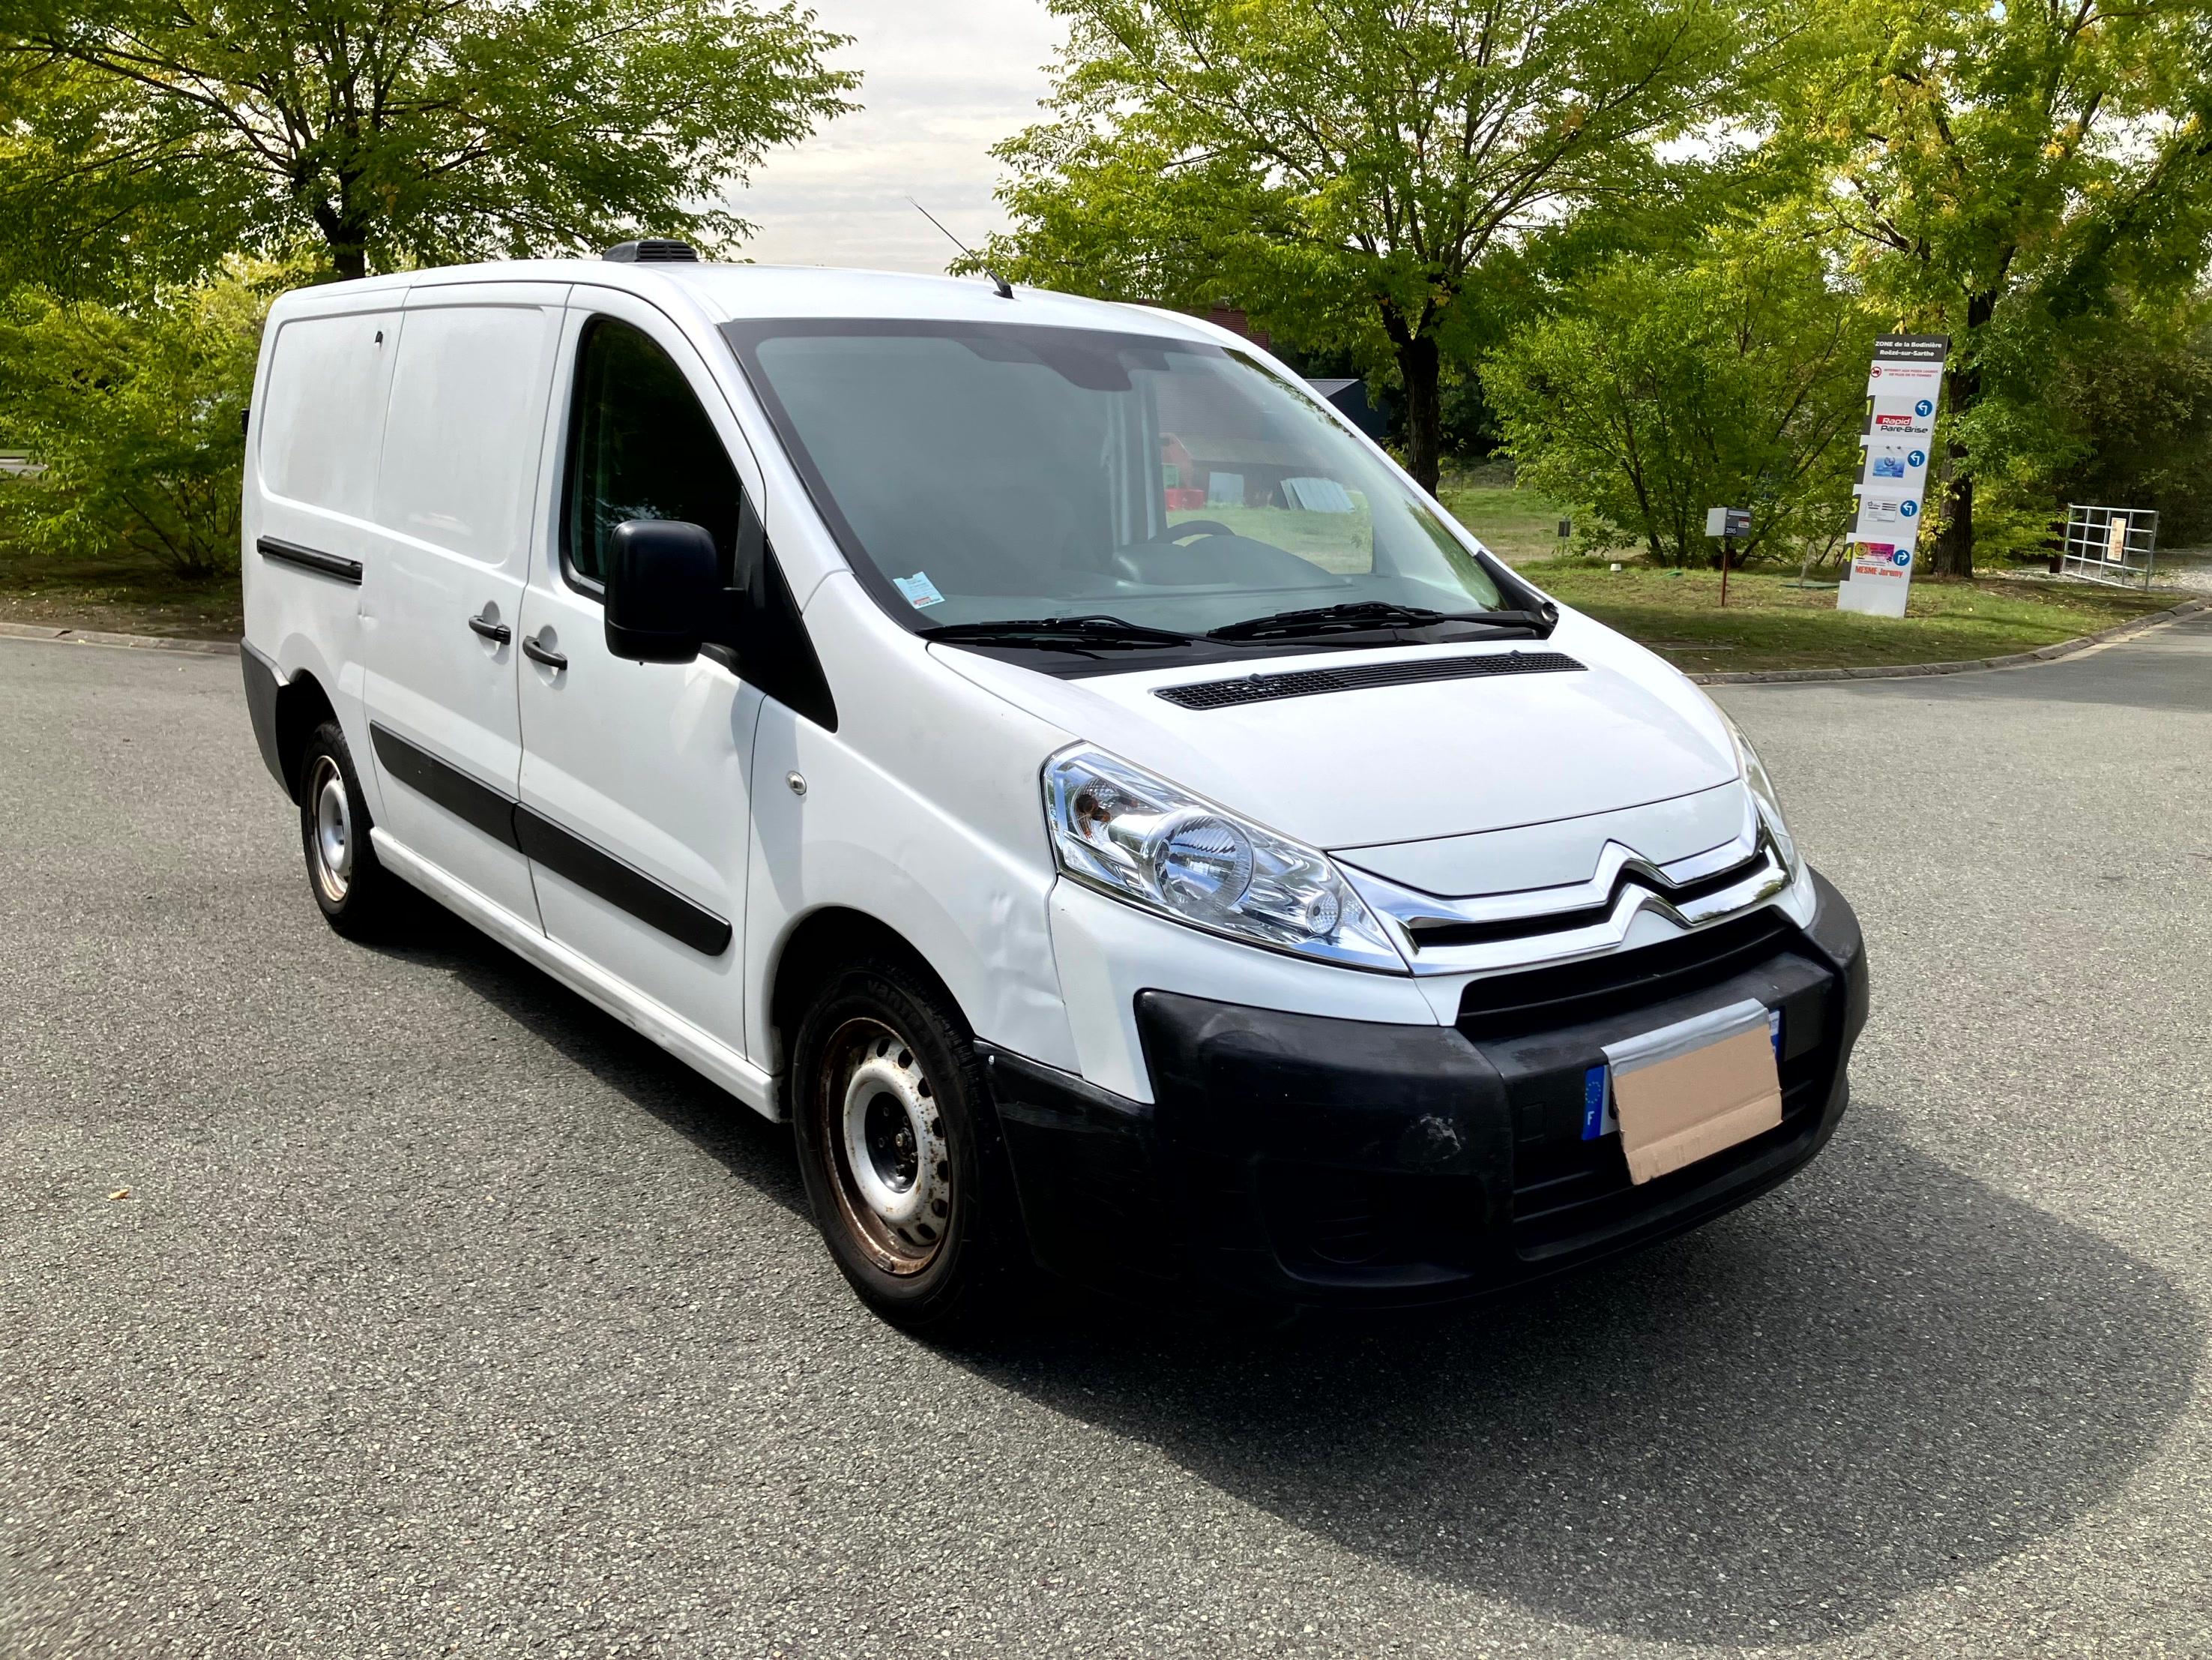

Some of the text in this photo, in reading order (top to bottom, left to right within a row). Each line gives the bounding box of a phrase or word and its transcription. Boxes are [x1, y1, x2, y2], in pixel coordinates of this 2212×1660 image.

[1866, 400, 1872, 415] 1
[1882, 417, 1911, 425] Rapid
[1880, 425, 1929, 433] Pare-Brise
[1857, 449, 1866, 465] 2
[1850, 498, 1859, 514] 3
[1843, 547, 1852, 562] 4
[1588, 1110, 1594, 1125] F
